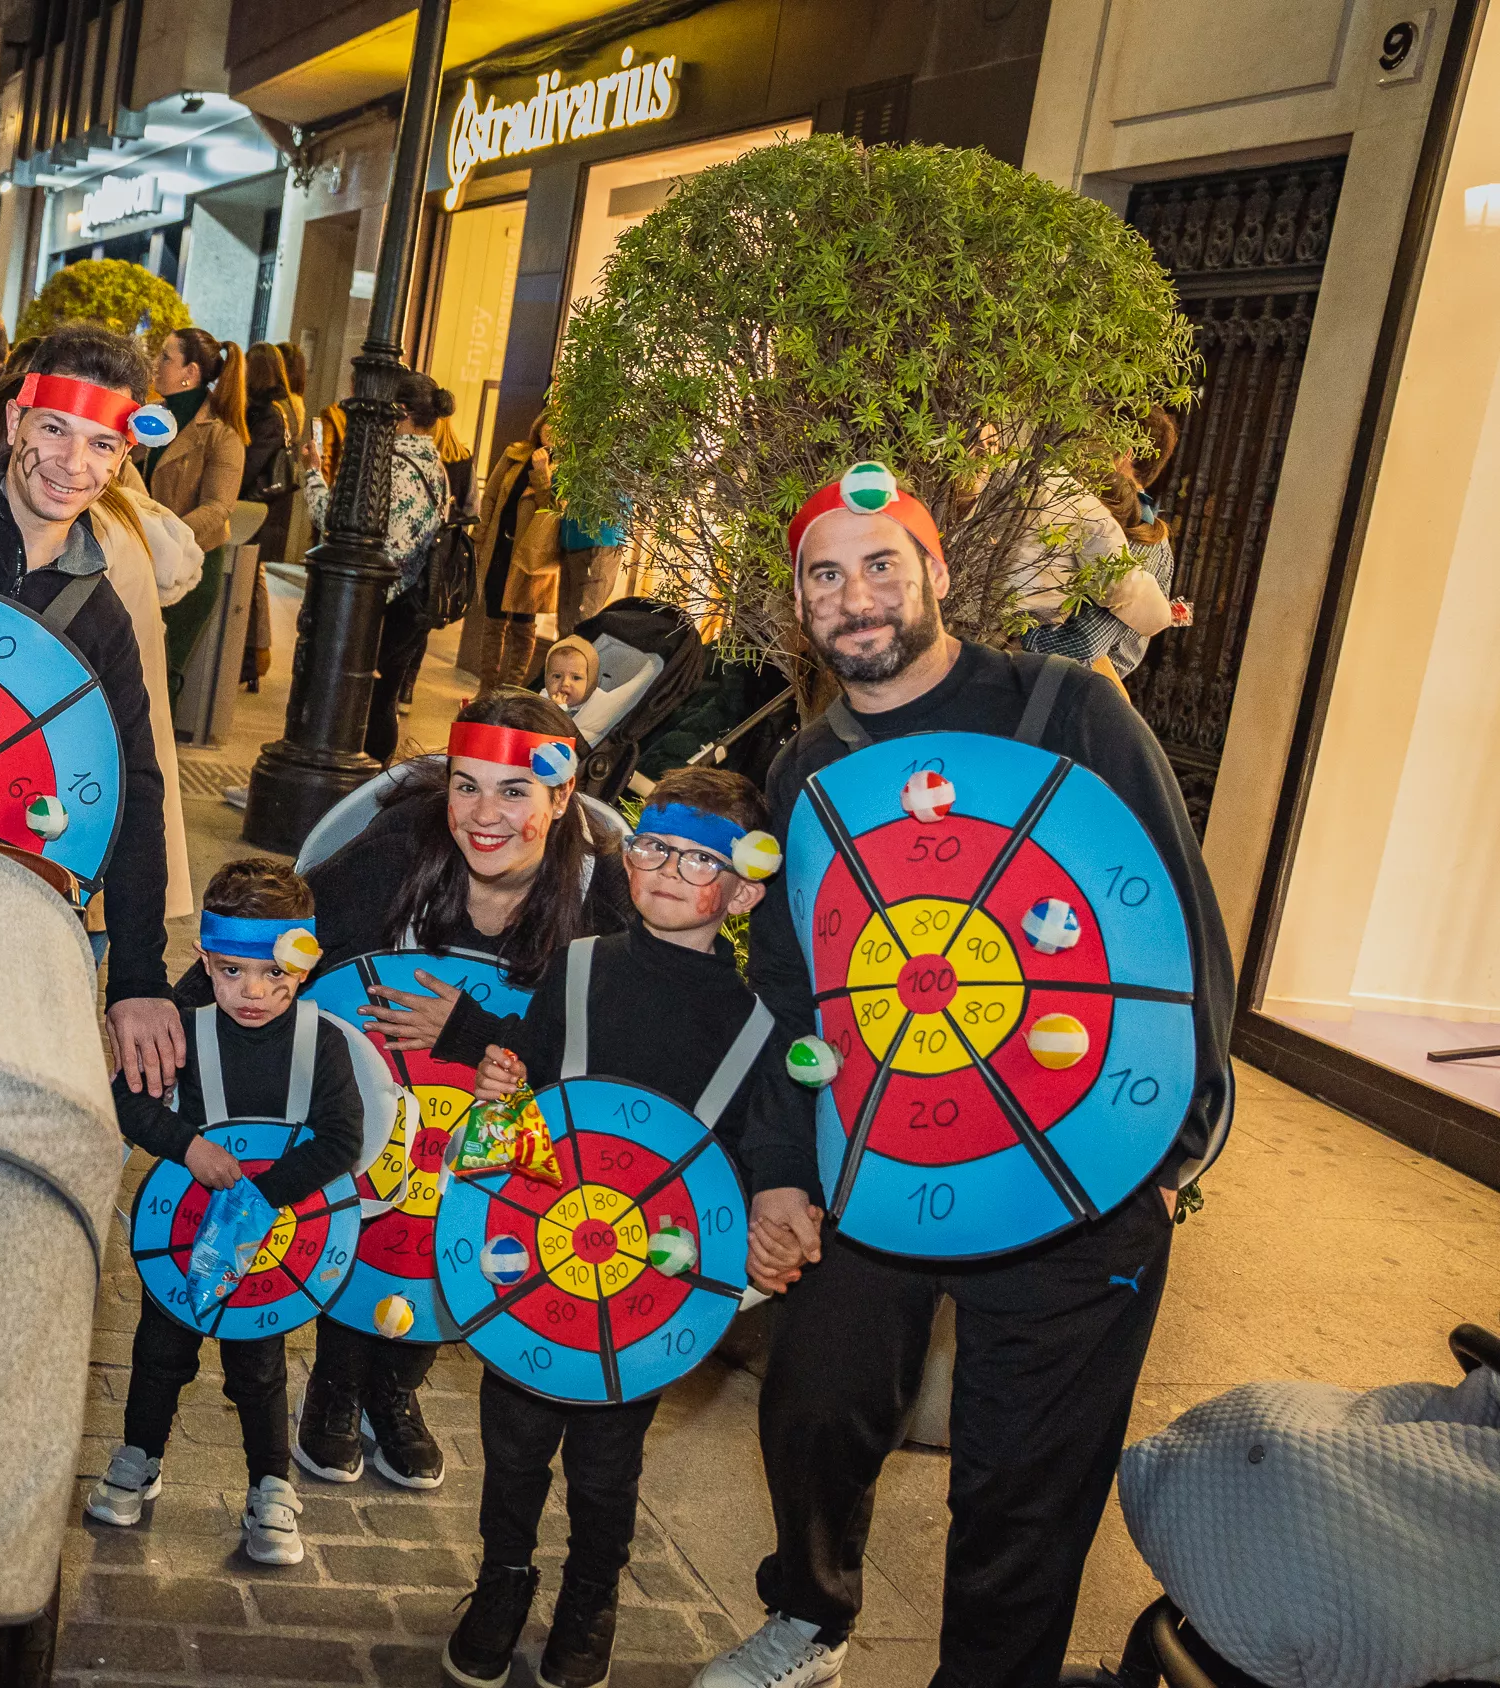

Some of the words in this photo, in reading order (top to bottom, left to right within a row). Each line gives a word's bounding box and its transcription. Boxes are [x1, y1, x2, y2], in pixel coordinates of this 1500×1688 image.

[1380, 22, 1414, 71] 9
[68, 772, 102, 805] 10
[907, 835, 960, 862] 50
[1105, 865, 1150, 907] 10
[818, 908, 841, 944] 40
[911, 910, 950, 936] 80
[860, 940, 892, 966] 90
[967, 937, 1000, 964] 90
[906, 969, 954, 993] 100
[859, 999, 890, 1026] 80
[963, 1001, 1005, 1025] 80
[913, 1030, 947, 1054] 90
[1107, 1069, 1159, 1106] 10
[429, 1098, 452, 1117] 90
[613, 1100, 650, 1129] 10
[909, 1099, 959, 1129] 20
[383, 1152, 403, 1173] 90
[601, 1151, 633, 1171] 50
[408, 1182, 436, 1200] 80
[594, 1193, 618, 1210] 80
[148, 1197, 172, 1215] 10
[557, 1202, 579, 1220] 90
[907, 1183, 955, 1225] 10
[702, 1206, 733, 1235] 10
[273, 1234, 288, 1245] 90
[543, 1236, 568, 1255] 80
[580, 1231, 615, 1248] 100
[620, 1225, 643, 1243] 90
[297, 1239, 317, 1256] 70
[326, 1248, 347, 1265] 10
[443, 1237, 473, 1272] 10
[565, 1265, 590, 1285] 90
[604, 1262, 629, 1284] 80
[167, 1287, 187, 1303] 10
[625, 1294, 655, 1316] 70
[255, 1311, 279, 1328] 10
[545, 1300, 576, 1324] 80
[660, 1328, 695, 1356] 10
[519, 1346, 552, 1373] 10
